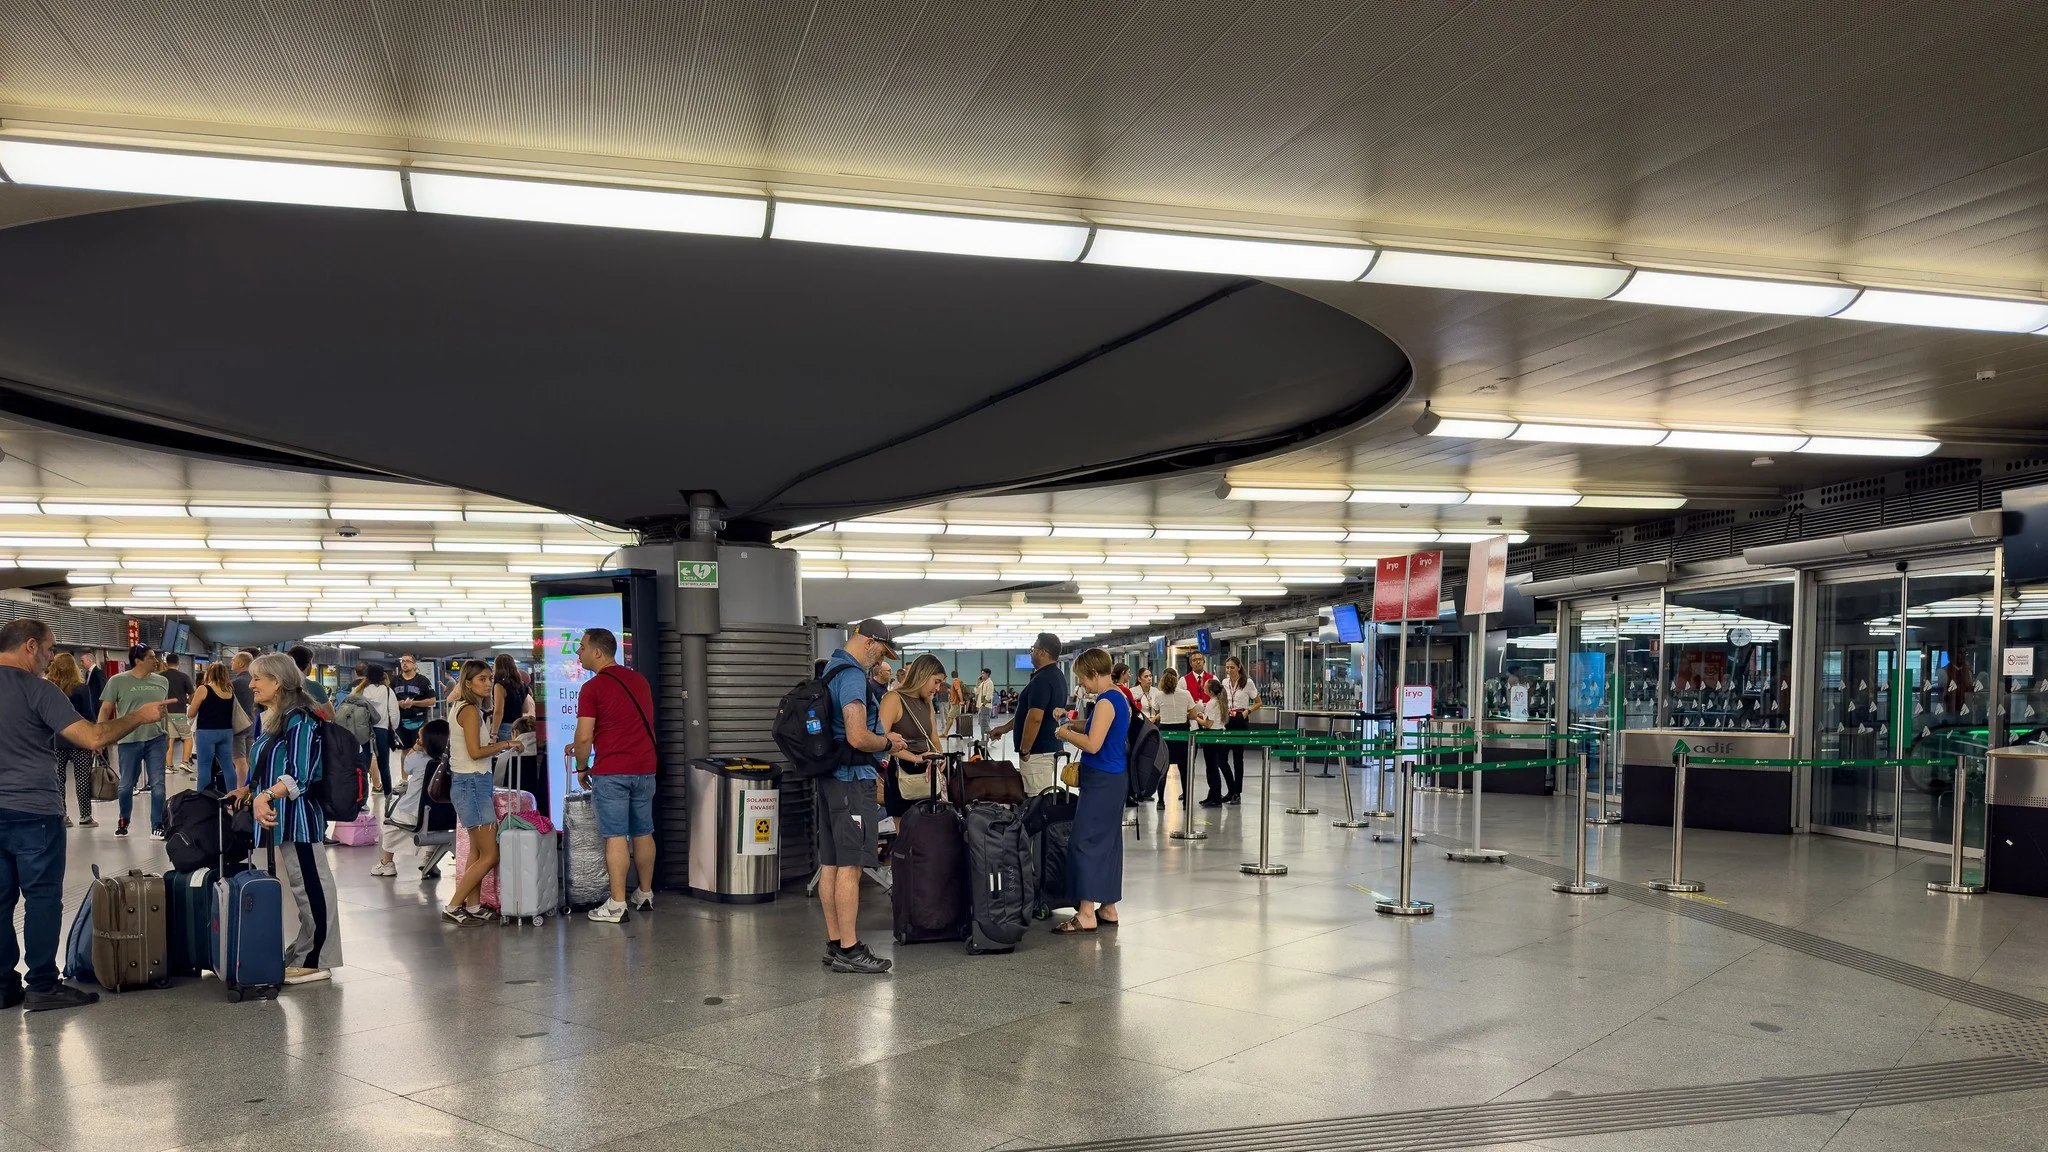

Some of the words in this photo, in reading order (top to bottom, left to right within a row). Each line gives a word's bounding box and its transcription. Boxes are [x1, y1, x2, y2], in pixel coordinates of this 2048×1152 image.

[1386, 561, 1399, 571] iryo
[1419, 557, 1432, 567] iryo
[1200, 633, 1207, 650] 5
[1497, 646, 1505, 673] 7
[559, 688, 567, 699] El
[1405, 689, 1423, 698] iryo
[562, 704, 572, 714] de
[1693, 742, 1736, 754] adif
